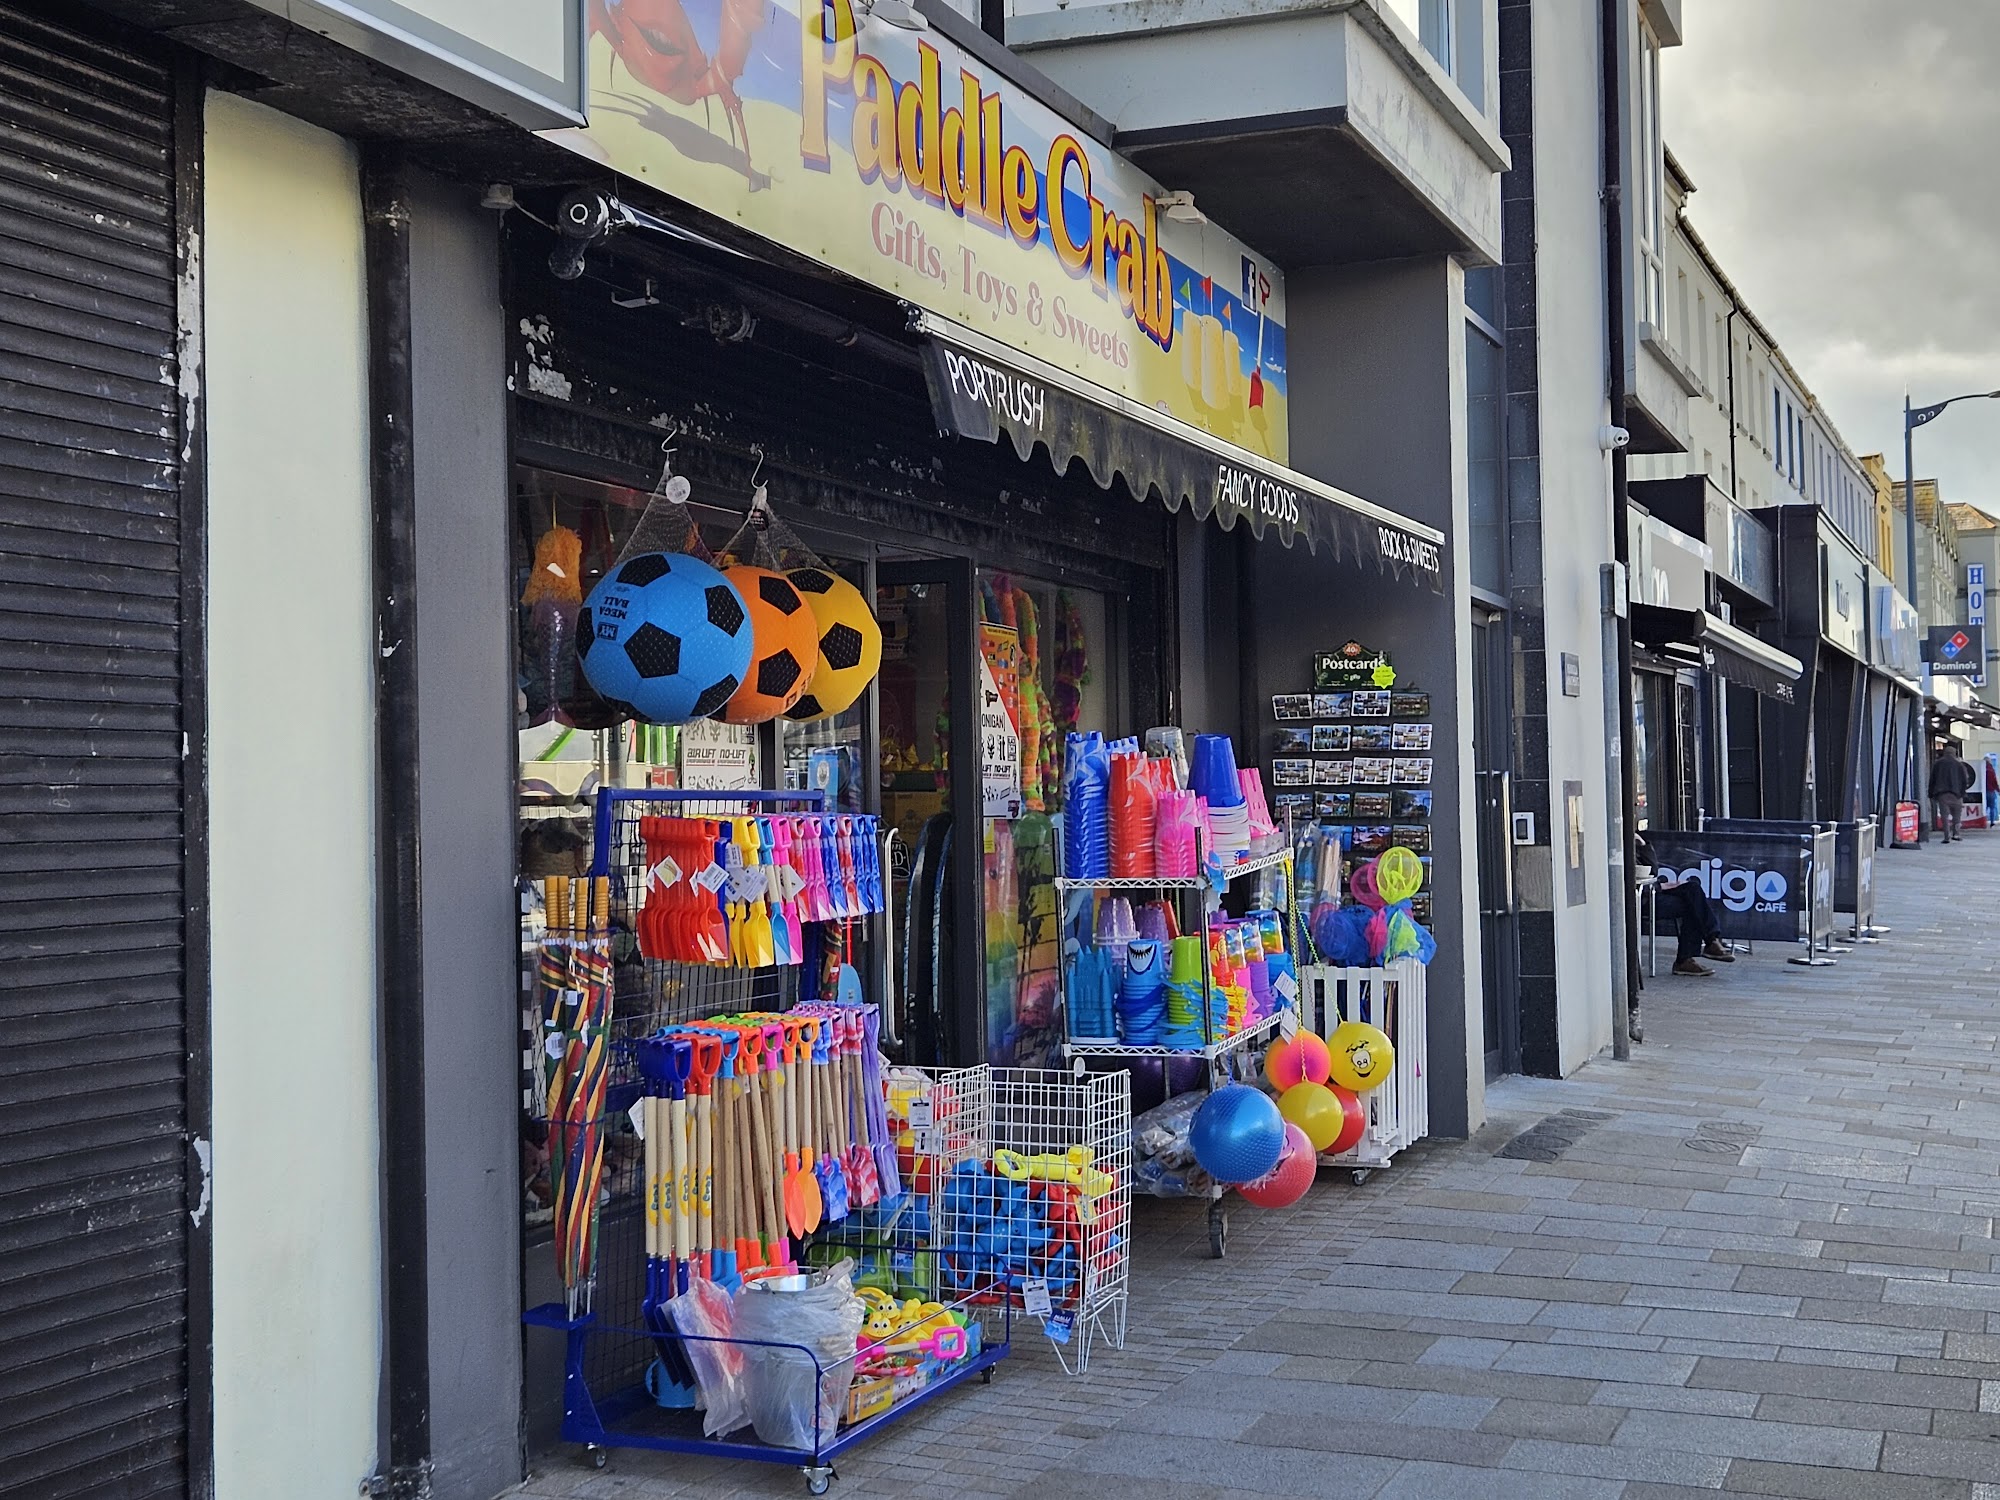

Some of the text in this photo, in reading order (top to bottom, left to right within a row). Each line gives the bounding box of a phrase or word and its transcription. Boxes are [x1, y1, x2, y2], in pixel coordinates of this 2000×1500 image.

[800, 0, 1174, 352] Paddle Crab
[871, 202, 1129, 369] Gifts, Toys & Sweets
[944, 349, 1045, 431] PORTRUSH
[1216, 464, 1299, 525] FANCY GOODS
[1378, 526, 1440, 574] ROCK & SWEETS
[599, 606, 628, 620] MEGA
[604, 596, 630, 608] BALL
[1932, 660, 1978, 671] Domino's
[1657, 857, 1788, 912] ndigo
